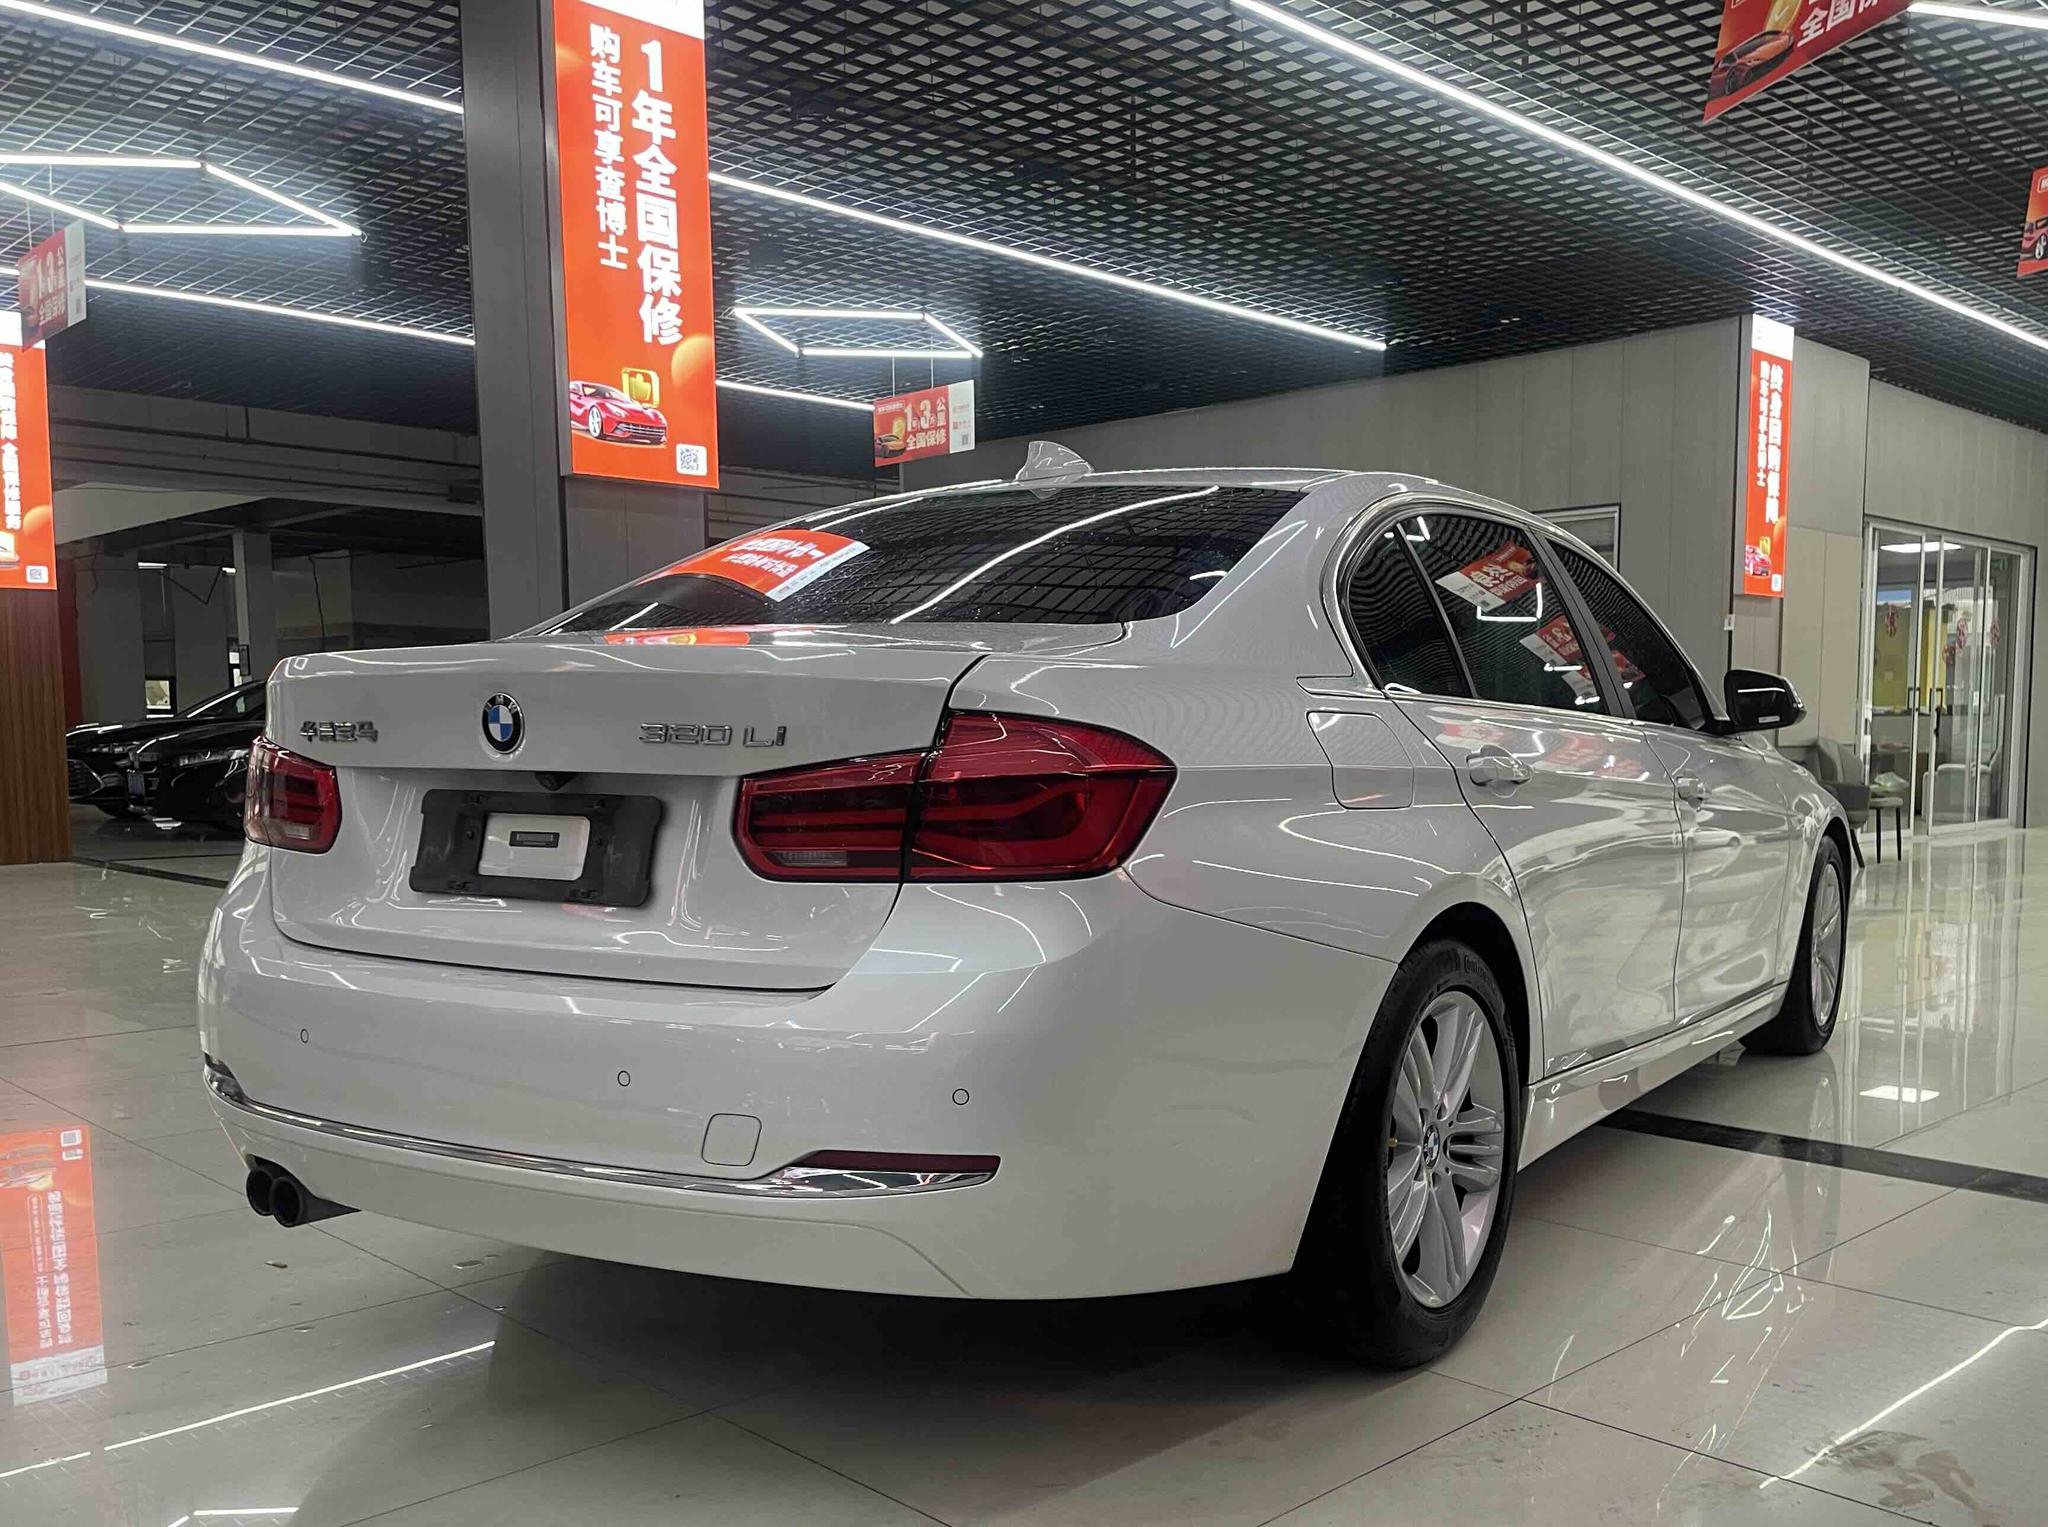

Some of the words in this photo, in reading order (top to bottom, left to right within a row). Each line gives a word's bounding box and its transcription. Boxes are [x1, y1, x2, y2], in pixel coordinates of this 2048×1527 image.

[589, 23, 628, 270] 购车可享查博士
[632, 40, 683, 345] 1年全国保修
[638, 723, 733, 746] 320
